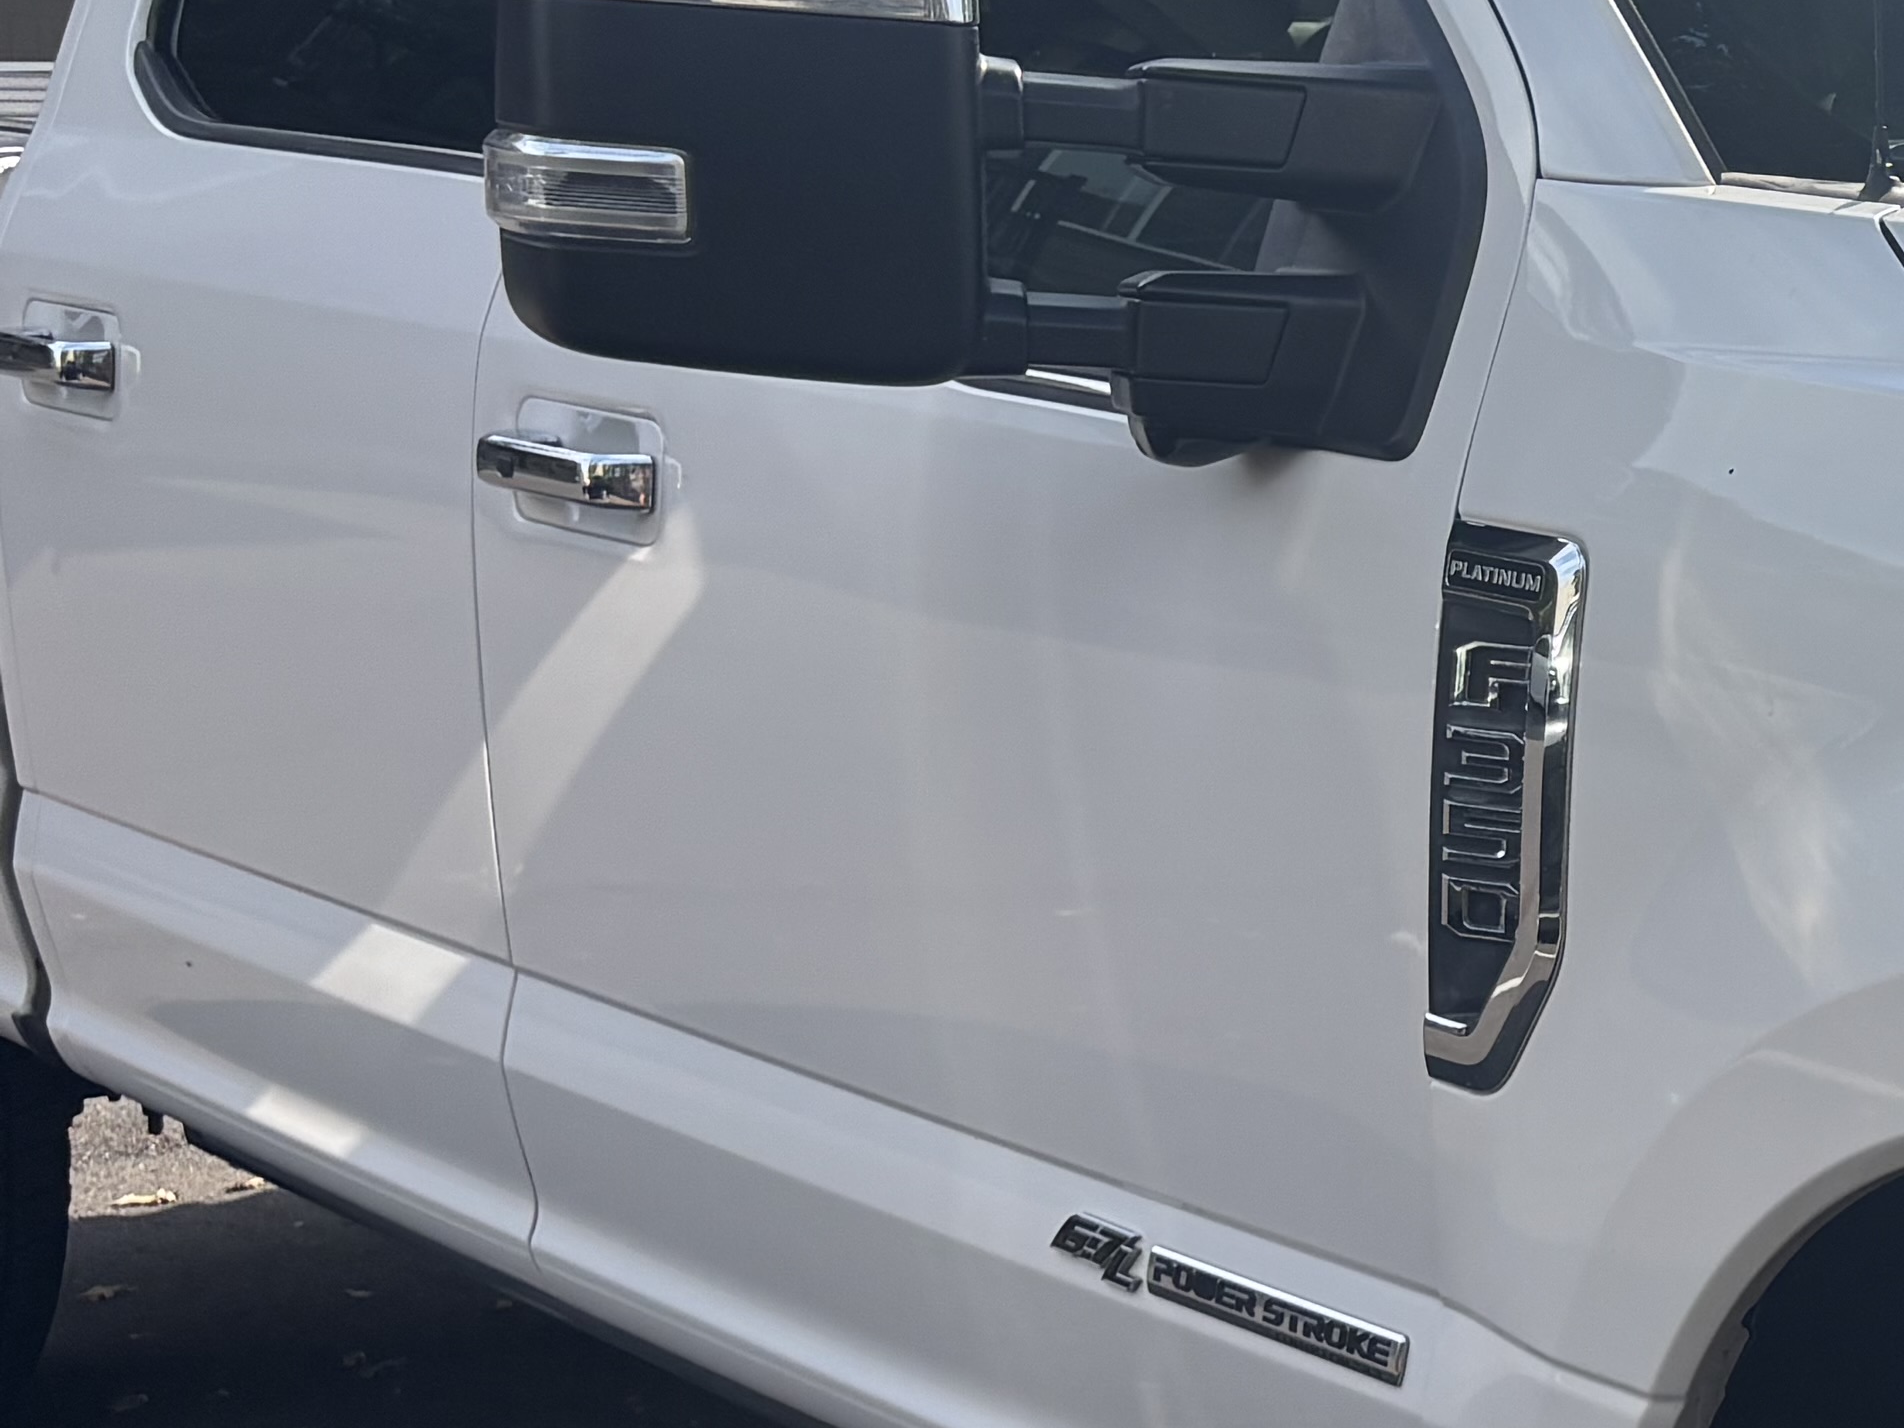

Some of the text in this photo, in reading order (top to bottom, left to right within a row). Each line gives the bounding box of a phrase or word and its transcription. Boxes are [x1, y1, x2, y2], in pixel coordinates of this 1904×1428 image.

[1449, 559, 1542, 592] PLATINUM
[1153, 1255, 1256, 1318] POWER
[1262, 1297, 1392, 1368] STROKE
